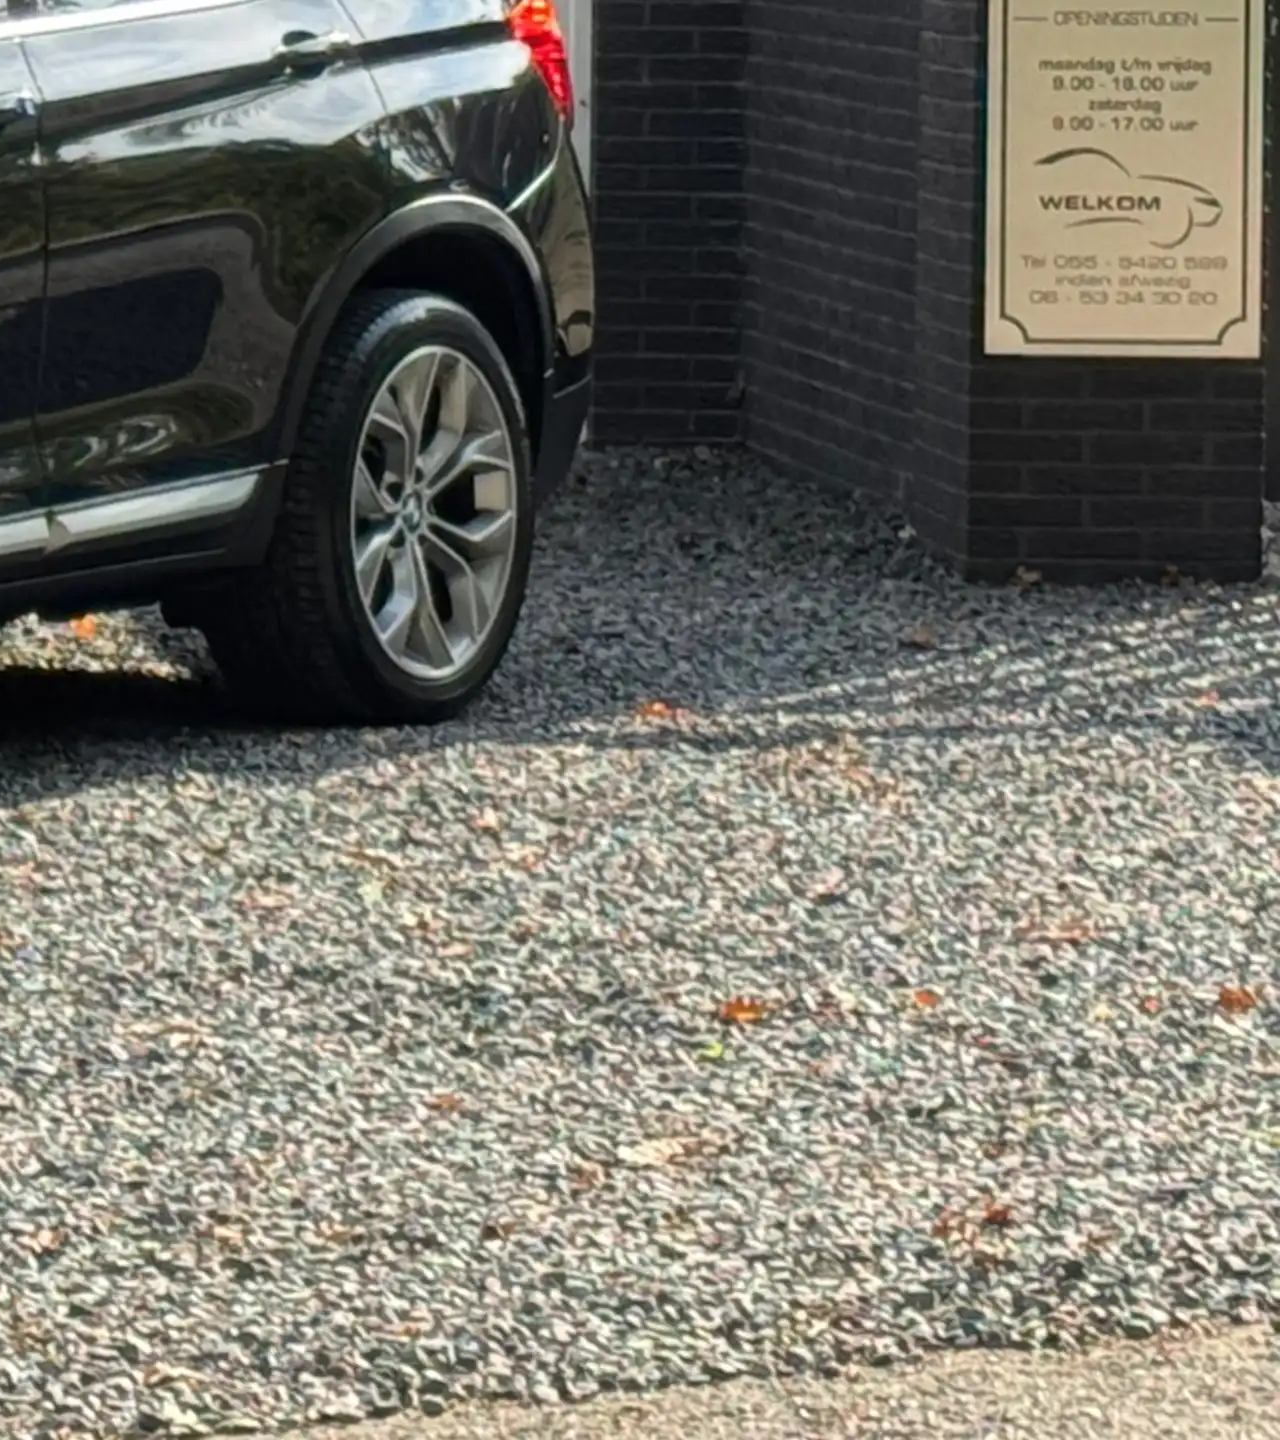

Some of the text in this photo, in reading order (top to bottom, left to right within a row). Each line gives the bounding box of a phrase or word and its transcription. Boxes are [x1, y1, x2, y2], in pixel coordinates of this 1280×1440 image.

[1038, 58, 1116, 75] maandag
[1156, 57, 1212, 75] vrijdag
[1170, 79, 1199, 91] uur
[1088, 98, 1163, 115] zaterdag
[1170, 119, 1199, 131] uur
[1039, 196, 1161, 211] WELKOM
